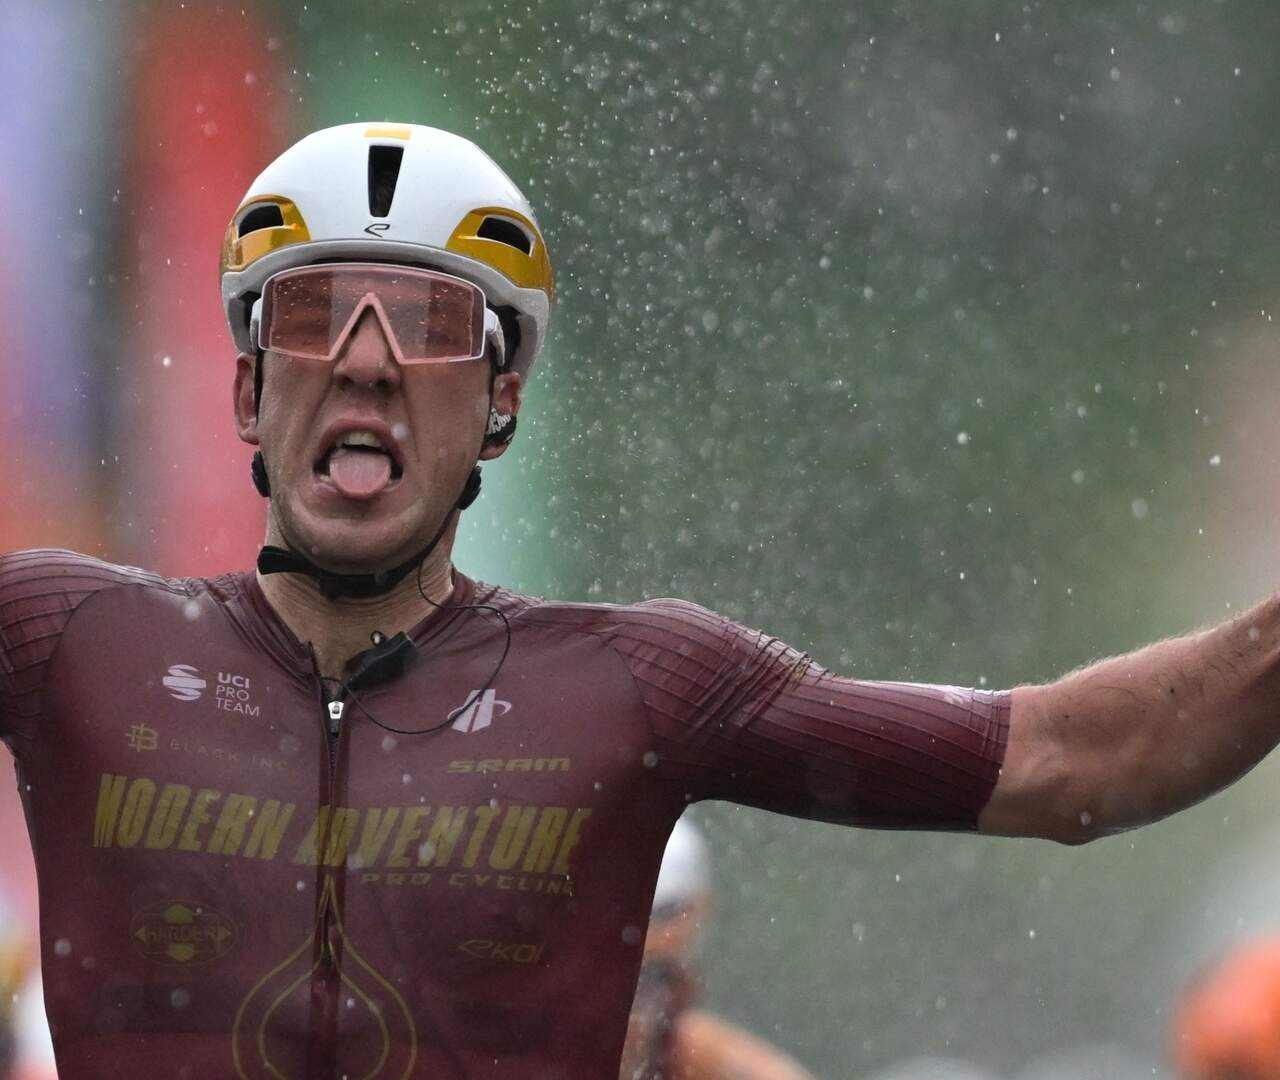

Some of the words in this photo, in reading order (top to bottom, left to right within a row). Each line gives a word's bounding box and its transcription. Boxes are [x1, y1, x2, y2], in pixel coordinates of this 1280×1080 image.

[218, 672, 250, 688] UCI
[216, 685, 250, 701] PRO
[216, 697, 260, 717] TEAM
[93, 773, 297, 860] MODERN
[292, 804, 593, 875] ADVENTURE
[360, 872, 431, 886] PRO
